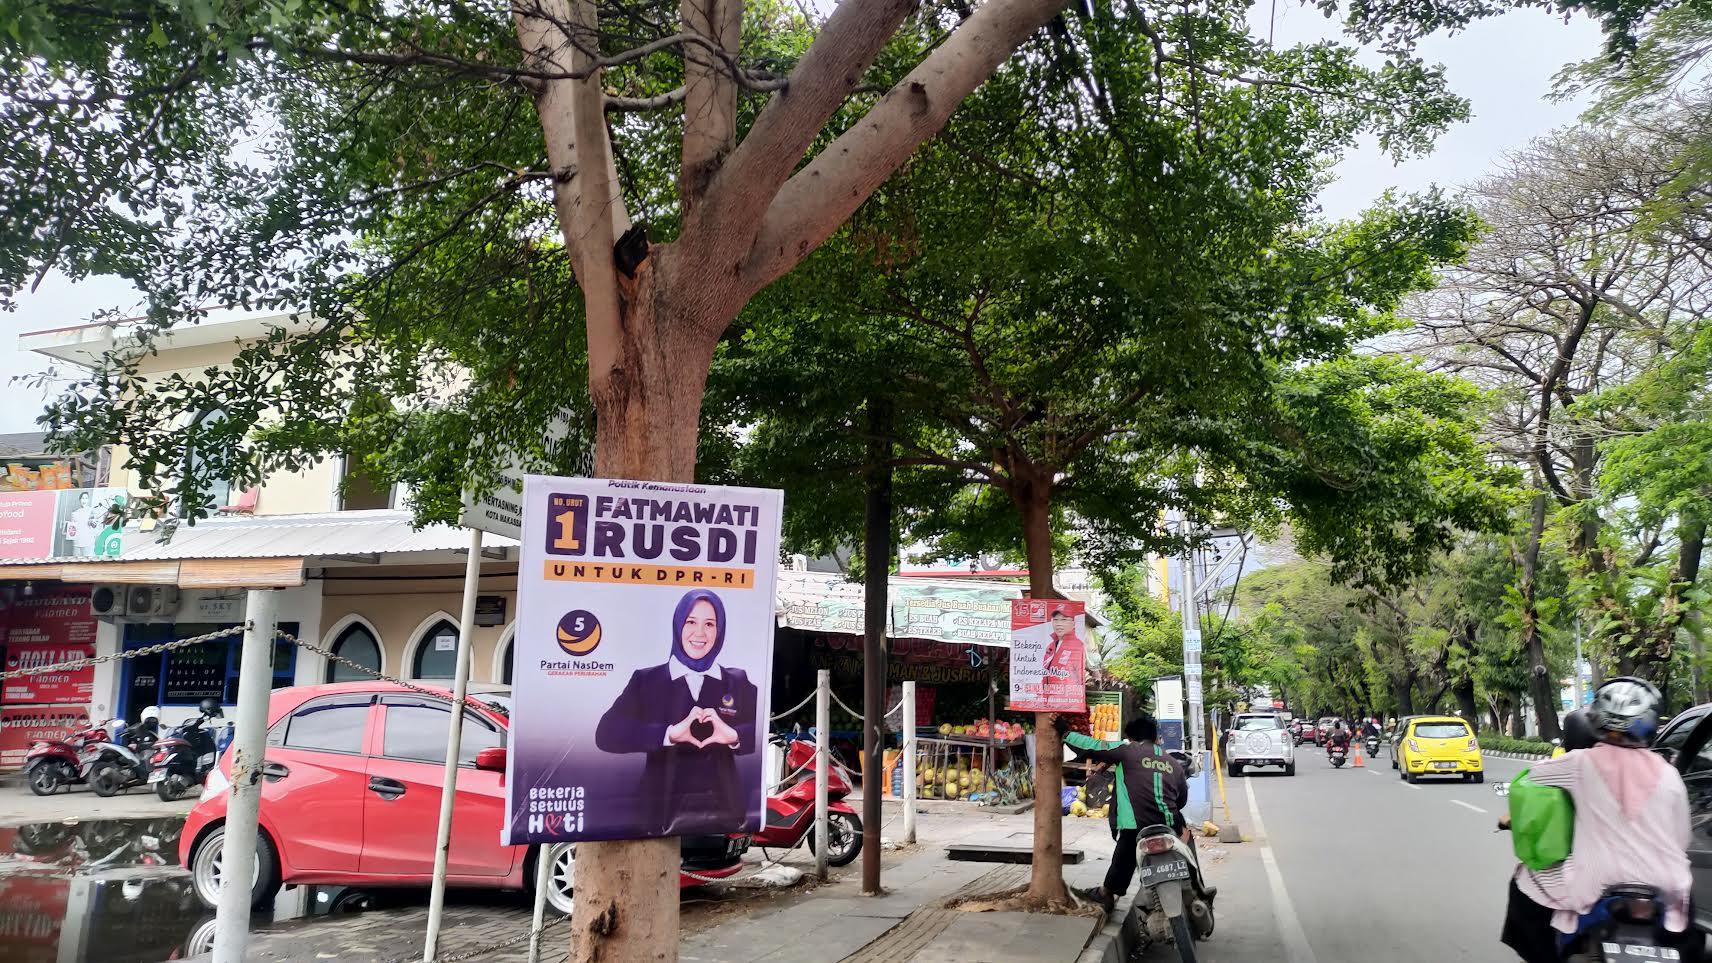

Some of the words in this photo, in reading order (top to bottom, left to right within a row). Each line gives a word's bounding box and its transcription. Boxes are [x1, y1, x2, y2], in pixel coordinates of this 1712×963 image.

[608, 479, 639, 490] Politik
[642, 482, 706, 494] Kemanusiaan
[486, 510, 499, 520] KOTA
[500, 514, 521, 527] MAKASSA
[595, 495, 759, 527] FATMAWATI
[553, 510, 579, 549] 1
[593, 520, 758, 564] RUSDI
[554, 564, 642, 580] UNTUK
[656, 569, 745, 584] DPR-RI
[804, 606, 829, 616] MELON
[1015, 602, 1030, 617] 15
[574, 617, 585, 632] 5
[919, 626, 942, 636] TELER
[1014, 640, 1042, 652] Bekerja
[540, 660, 571, 669] Partai
[572, 660, 614, 670] NasDem
[1014, 653, 1037, 663] Untuk
[1013, 666, 1048, 677] Indonesia
[1050, 666, 1069, 679] Maju
[12, 713, 77, 728] HOLLAND
[1141, 756, 1174, 774] Grab
[529, 786, 585, 801] Bekerja
[529, 799, 585, 812] setulus
